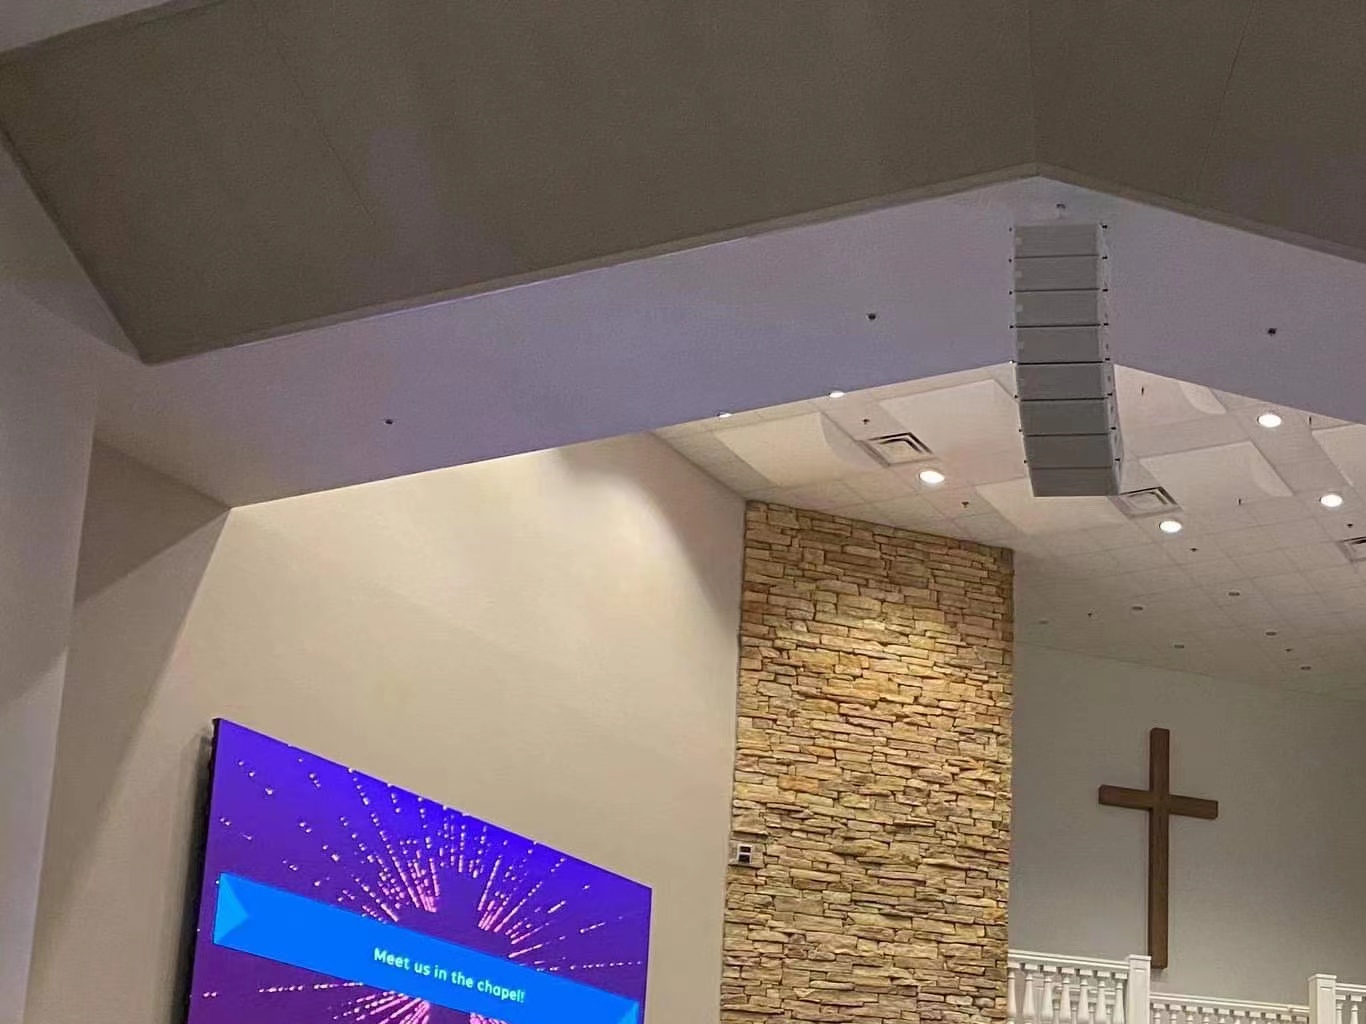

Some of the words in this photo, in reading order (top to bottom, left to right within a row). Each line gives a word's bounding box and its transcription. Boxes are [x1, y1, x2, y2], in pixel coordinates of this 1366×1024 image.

[373, 947, 411, 970] Meet
[413, 961, 431, 976] us
[433, 964, 447, 982] in
[450, 971, 474, 989] the
[476, 979, 525, 1004] chapel!
